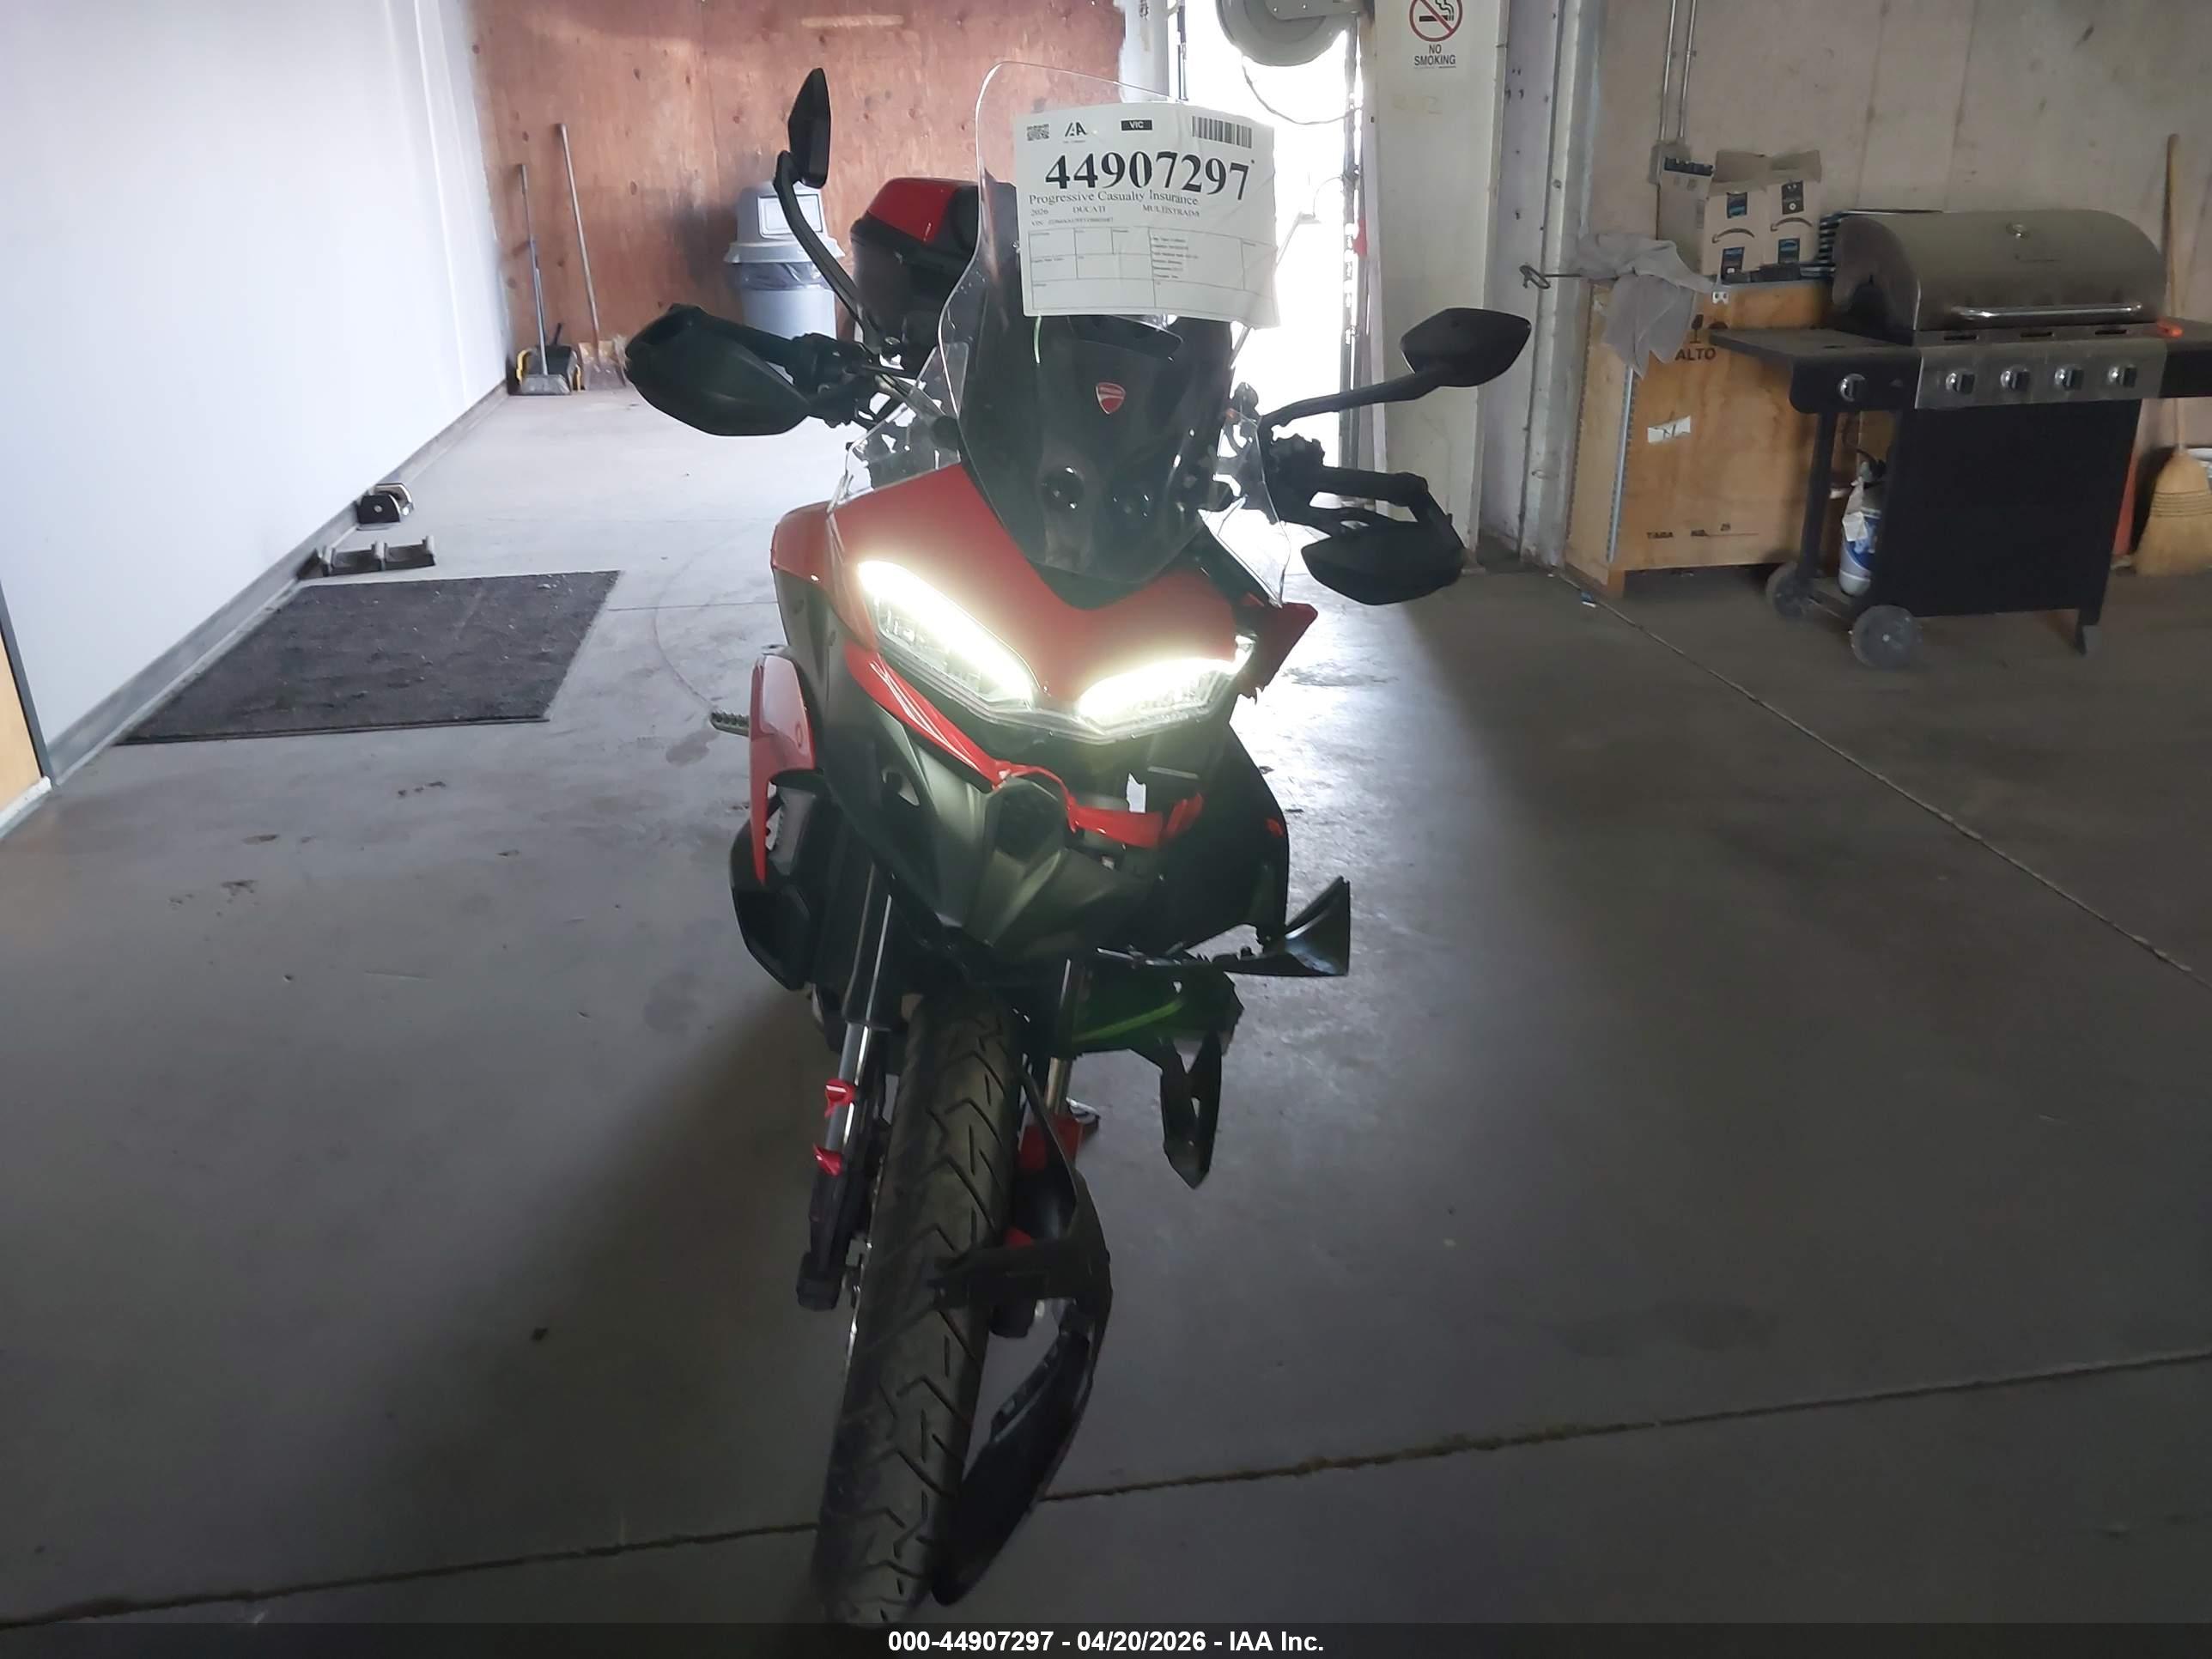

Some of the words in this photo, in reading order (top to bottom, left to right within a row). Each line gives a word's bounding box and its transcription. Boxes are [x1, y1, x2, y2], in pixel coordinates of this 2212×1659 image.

[1429, 44, 1442, 54] NO
[1414, 54, 1456, 65] SMOKING
[1129, 120, 1145, 130] VIC
[1045, 150, 1249, 201] 44907297
[1030, 192, 1095, 205] Progressive
[1097, 191, 1145, 203] Casualty
[1149, 189, 1199, 206] Insurance
[1072, 205, 1106, 214] DUCATI
[1674, 348, 1717, 361] ALTO
